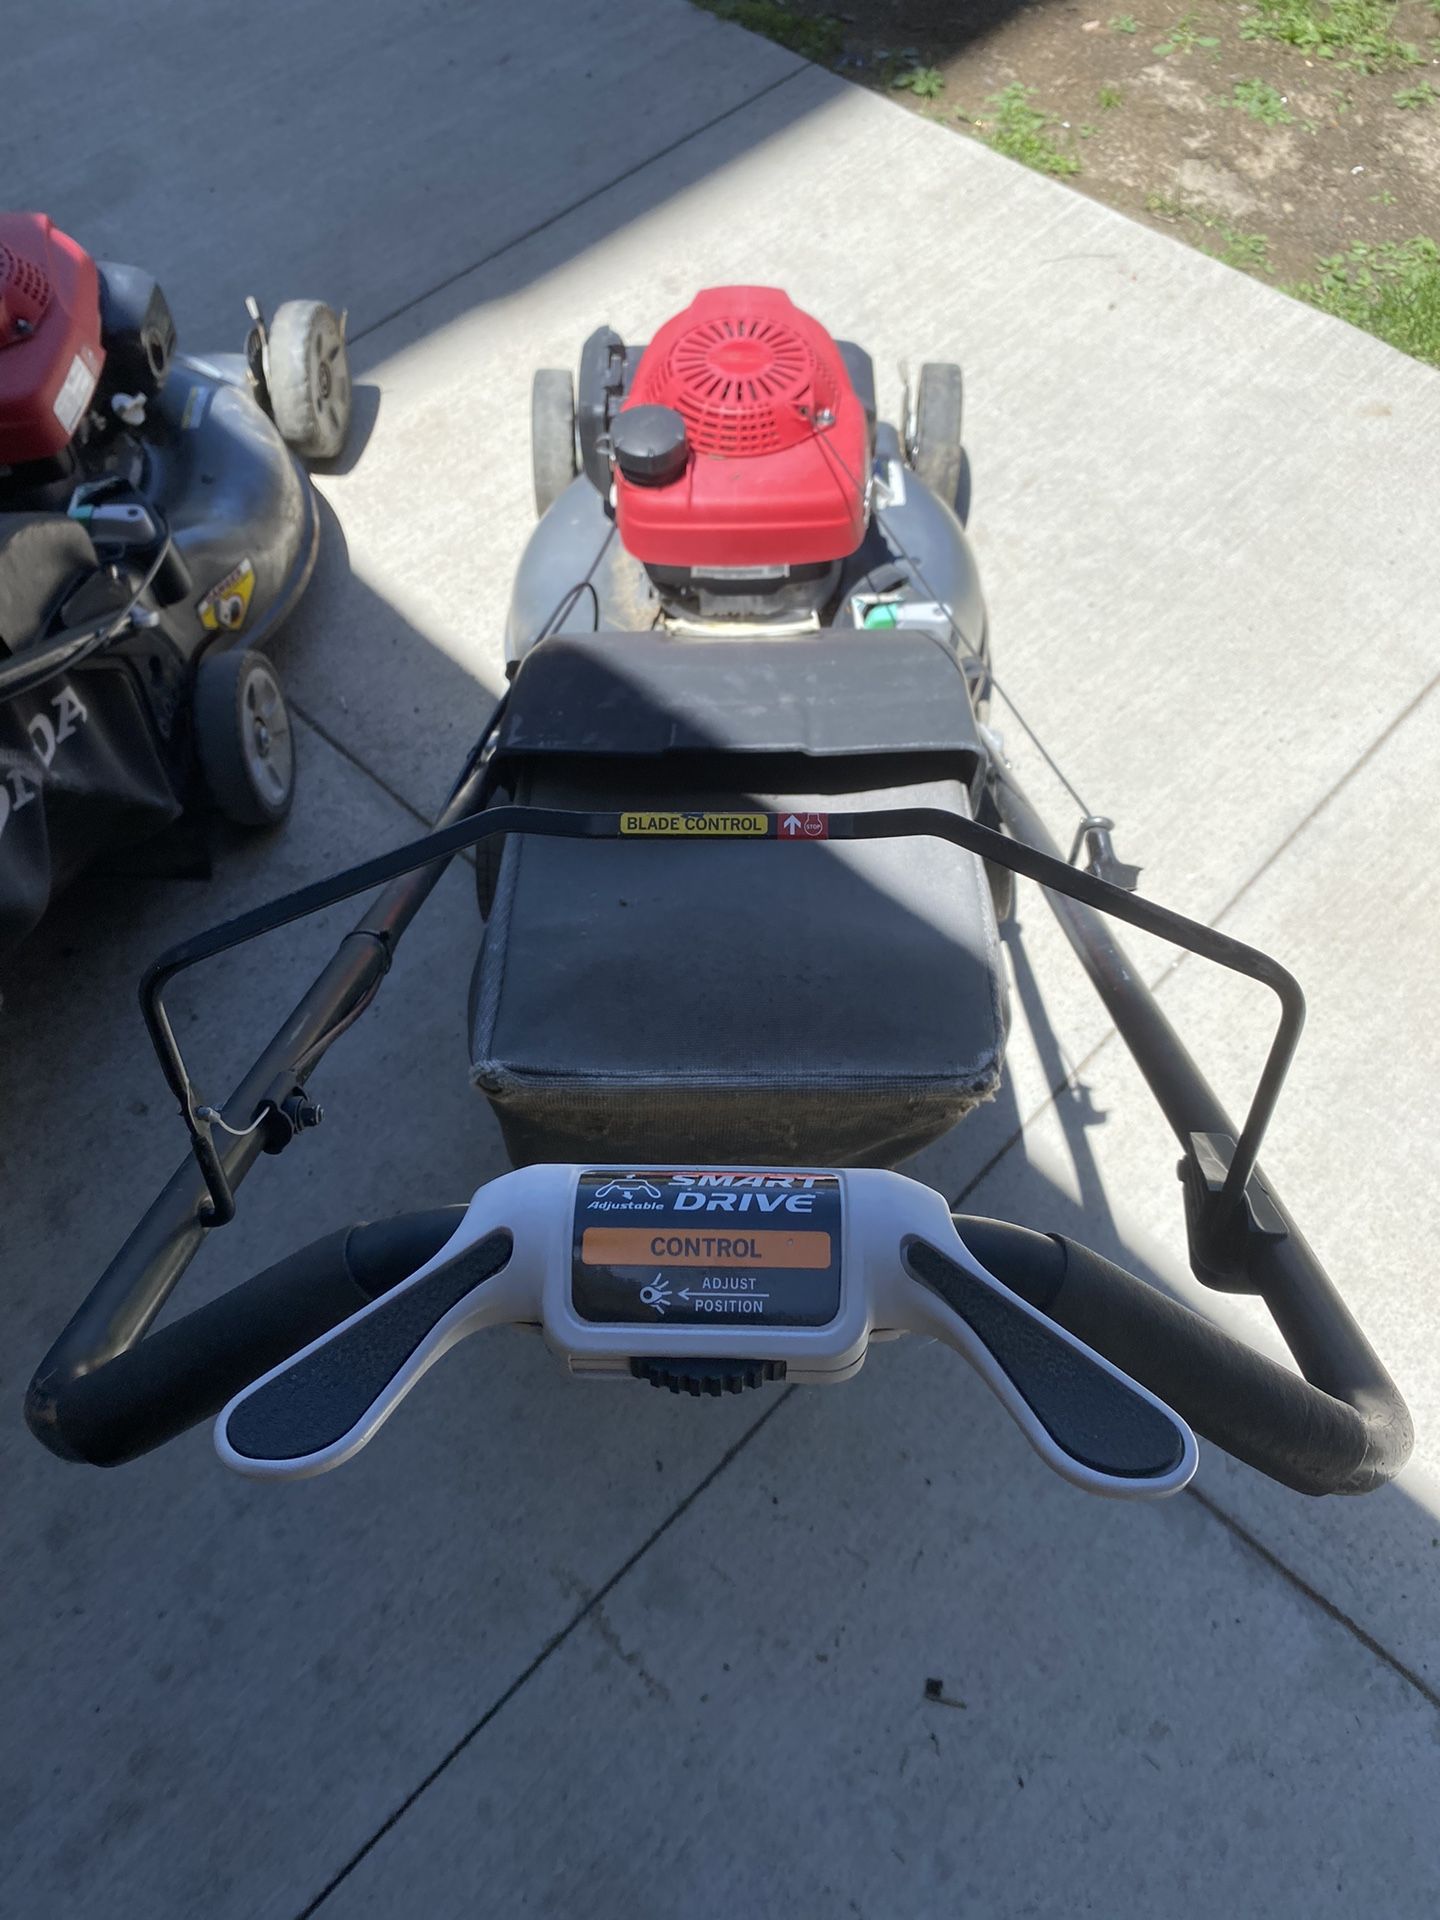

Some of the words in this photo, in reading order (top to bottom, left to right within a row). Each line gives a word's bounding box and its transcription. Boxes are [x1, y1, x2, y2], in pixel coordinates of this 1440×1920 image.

[626, 816, 680, 831] BLADE
[684, 816, 762, 831] CONTROL
[668, 1174, 817, 1189] SMART
[586, 1201, 665, 1211] Adjustable
[673, 1192, 817, 1213] DRIVE
[650, 1236, 762, 1259] CONTROL
[701, 1277, 757, 1290] ADJUST
[694, 1299, 763, 1313] POSITION
